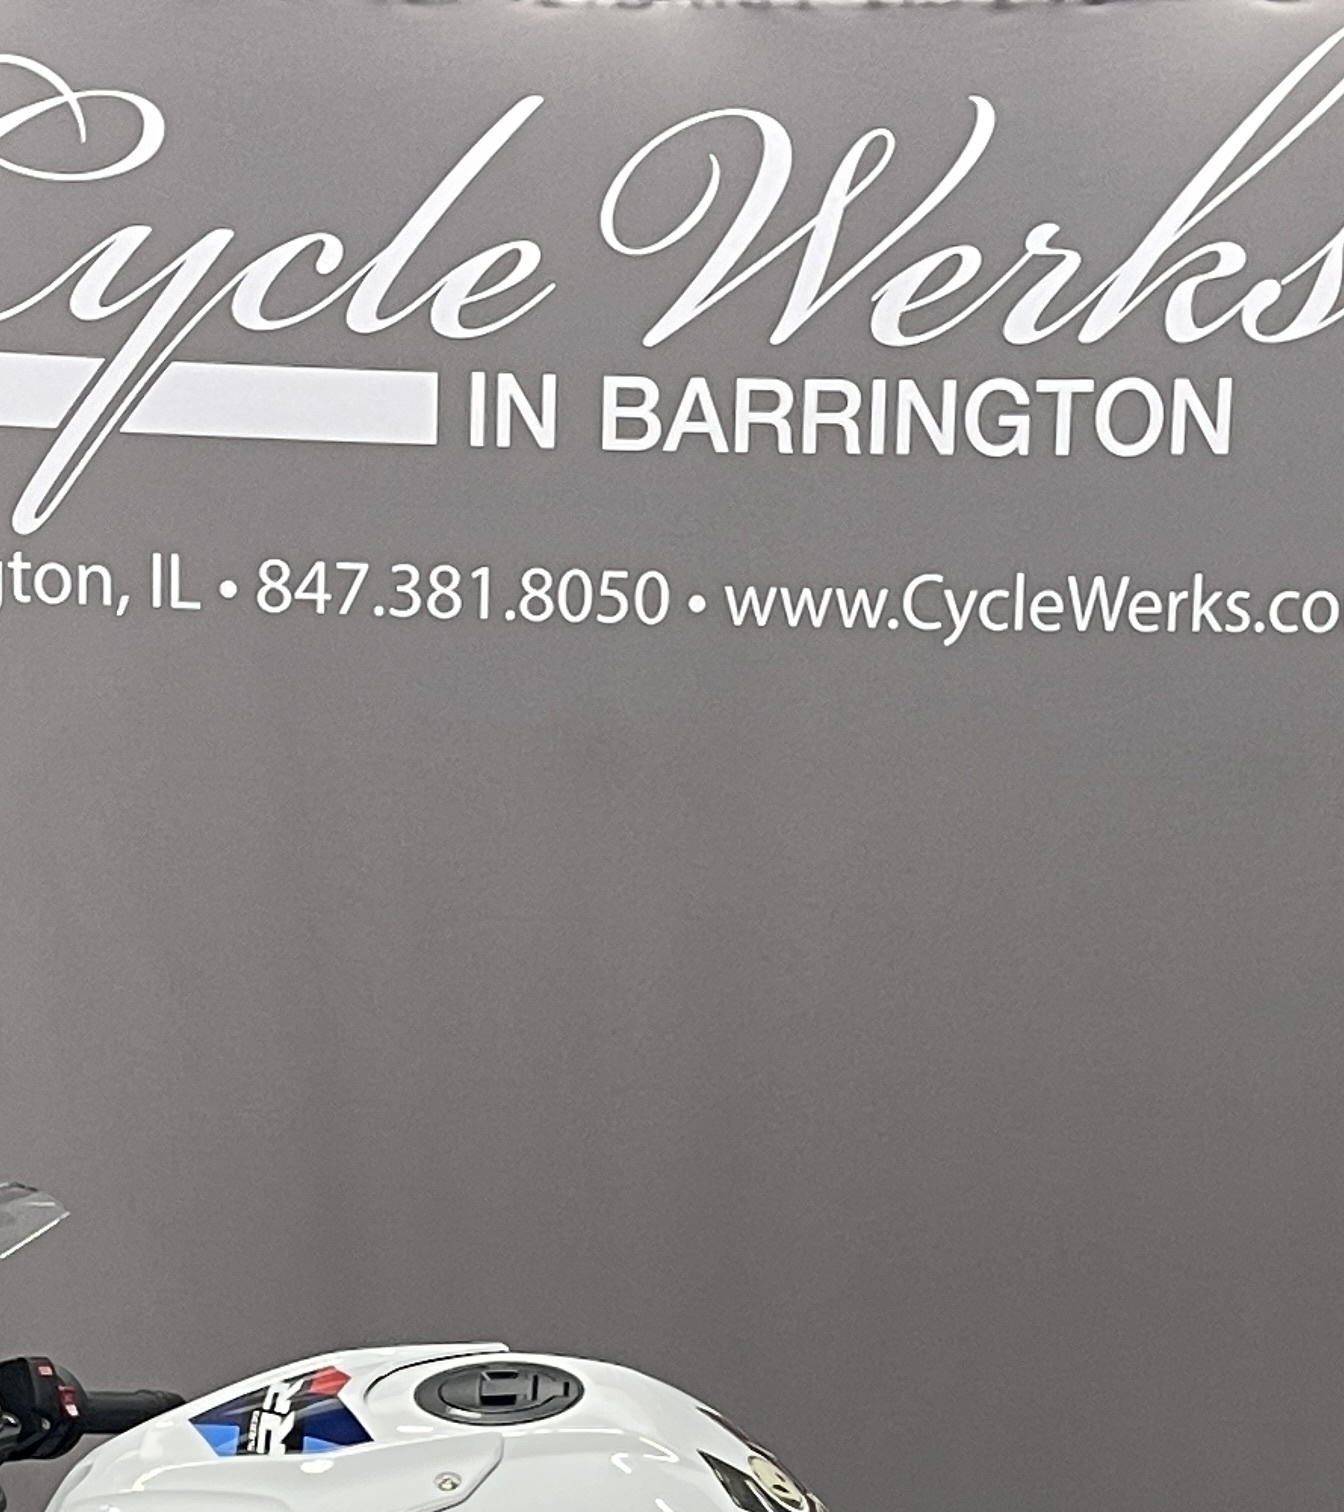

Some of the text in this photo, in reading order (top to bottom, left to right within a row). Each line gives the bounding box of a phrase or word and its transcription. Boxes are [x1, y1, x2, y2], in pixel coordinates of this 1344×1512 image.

[469, 371, 1234, 458] IN BARRINGTON
[152, 552, 201, 610] IL
[256, 557, 670, 625] 847.381.8050
